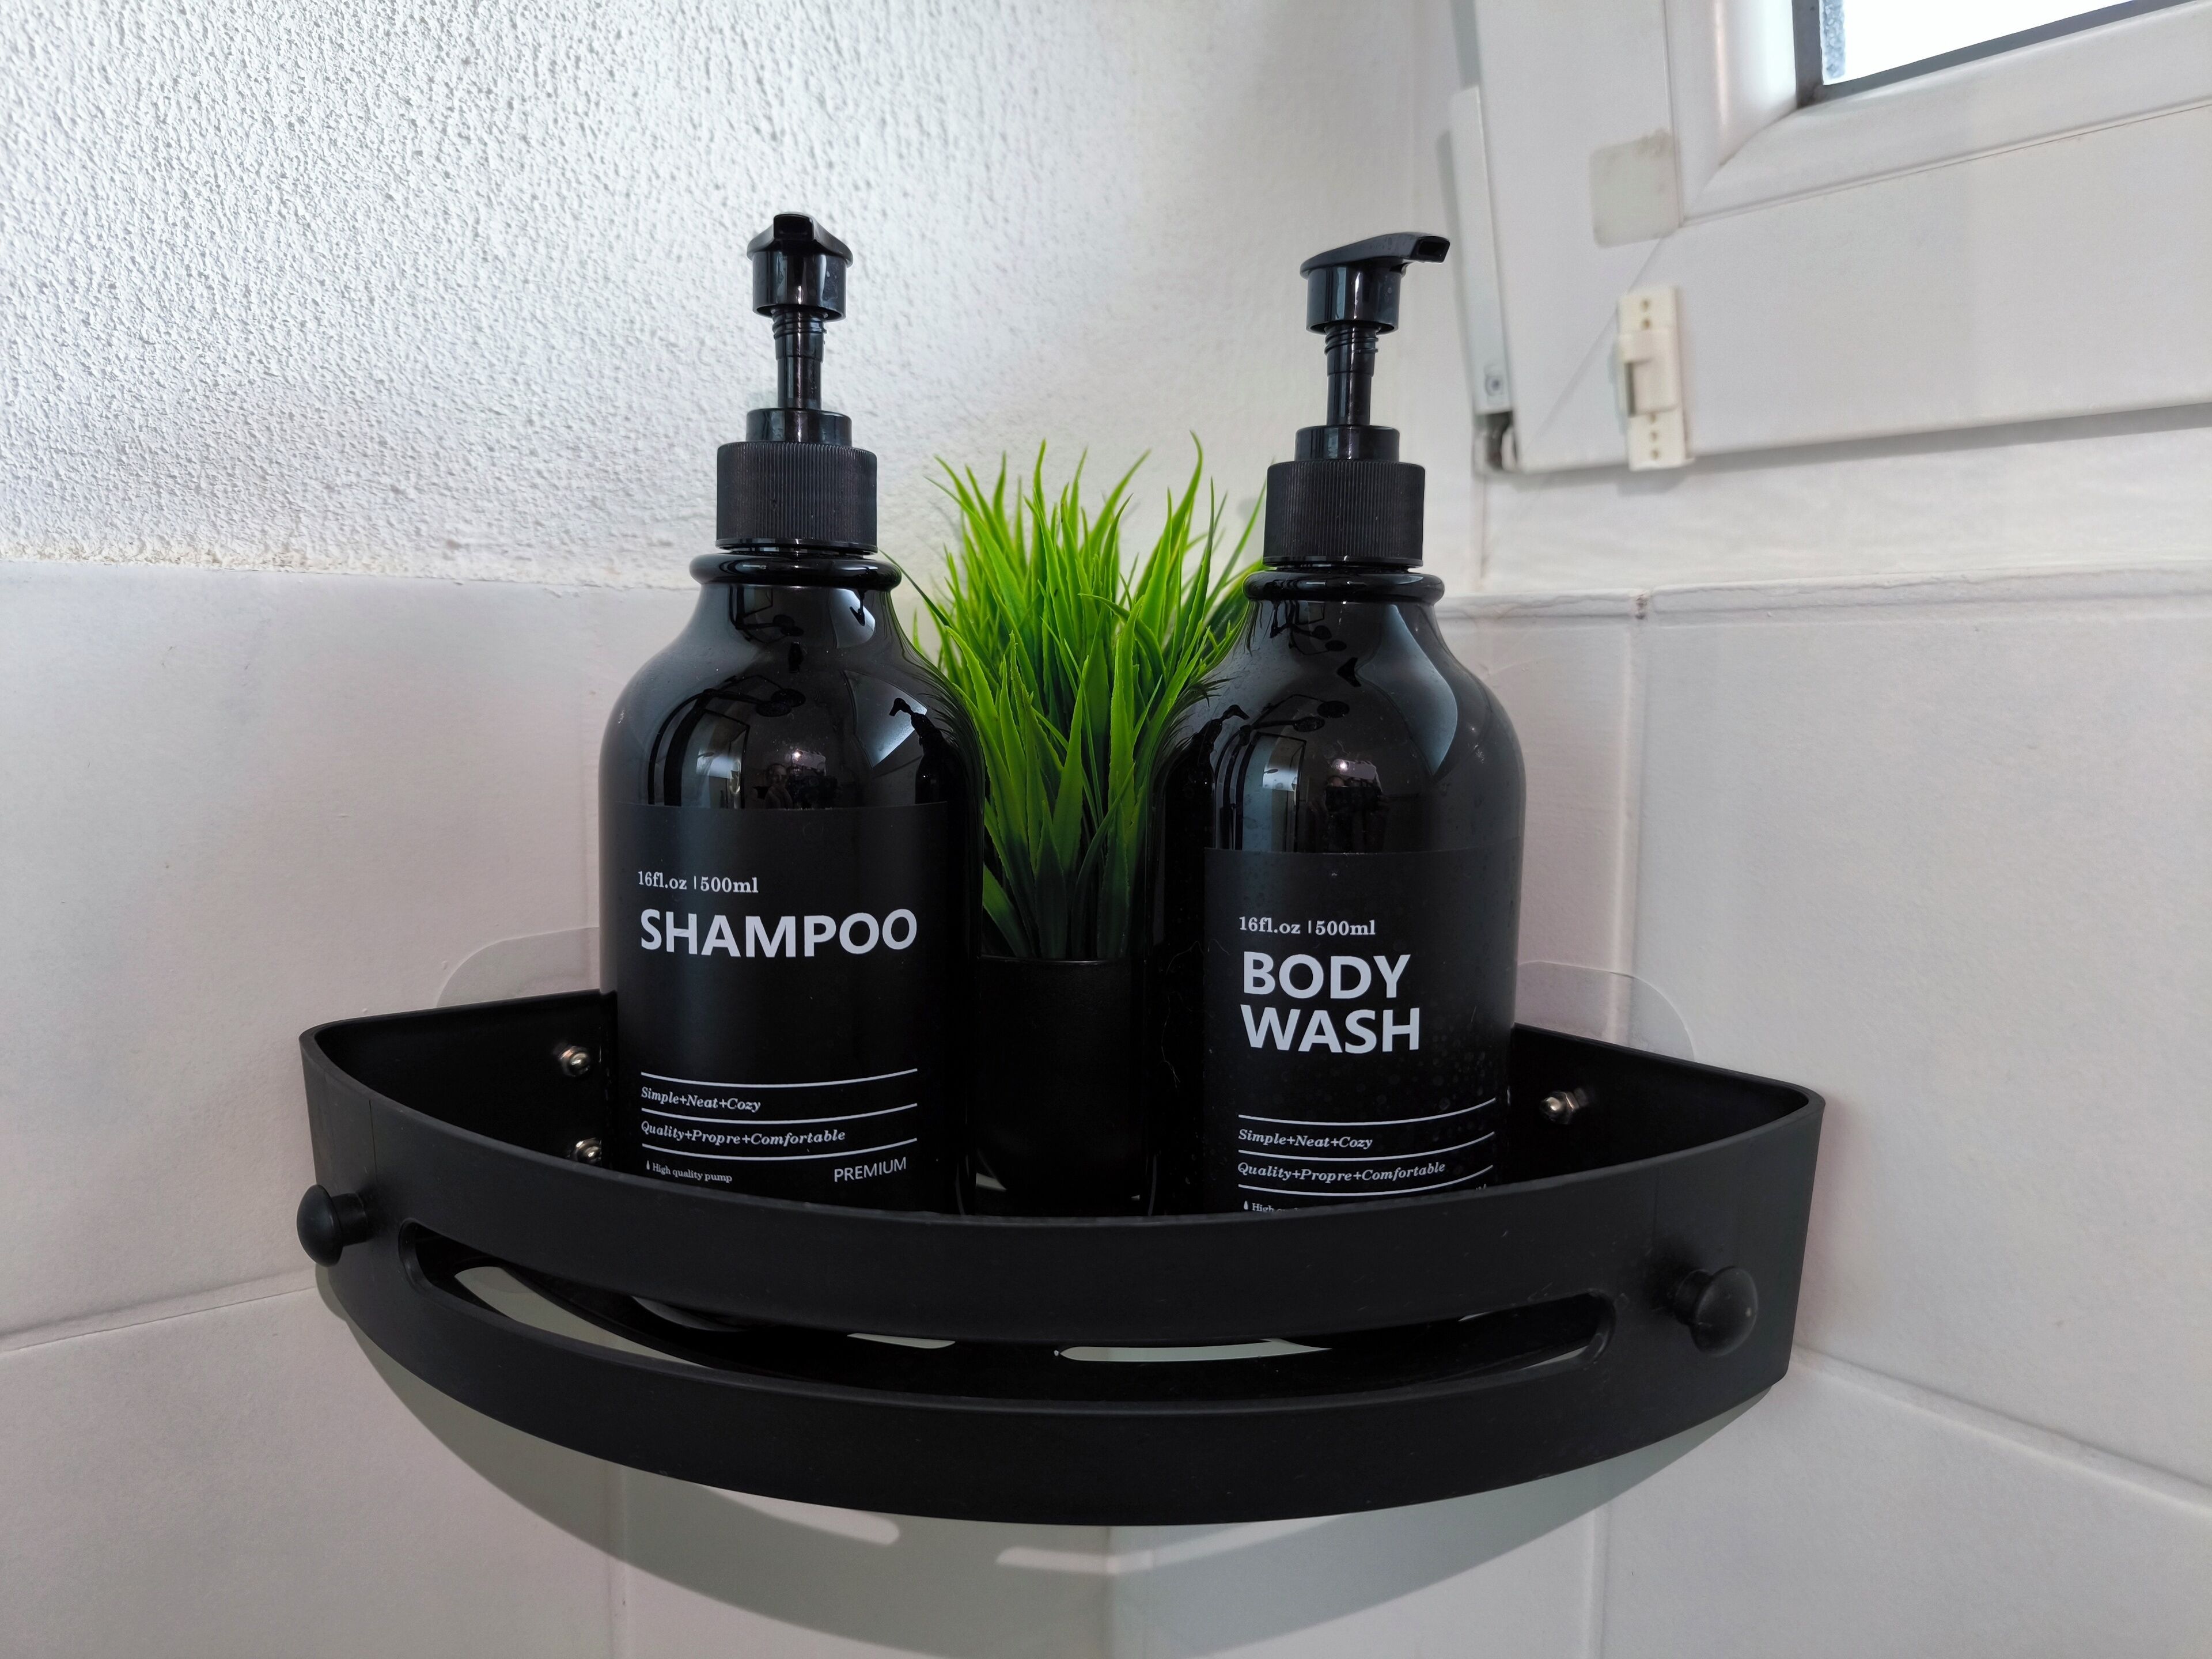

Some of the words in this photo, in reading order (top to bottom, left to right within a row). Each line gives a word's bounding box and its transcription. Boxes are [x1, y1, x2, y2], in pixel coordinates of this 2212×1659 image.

[638, 870, 687, 890] 16fl.oz
[641, 908, 917, 957] SHAMPOO
[1239, 916, 1301, 934] 16fl.oz
[1244, 951, 1411, 999] BODY
[1240, 1004, 1420, 1054] WASH
[641, 1086, 761, 1112] Simple+Neat+Cozy
[641, 1121, 846, 1147] Quality+Propre+Comfortable
[1238, 1129, 1373, 1149] Simple+Neat+Cozy
[652, 1162, 671, 1176] High
[672, 1169, 703, 1181] quality
[704, 1173, 733, 1183] pump
[834, 1156, 907, 1183] PREMIUM
[1237, 1162, 1446, 1183] Quality+Propre+Comfortable
